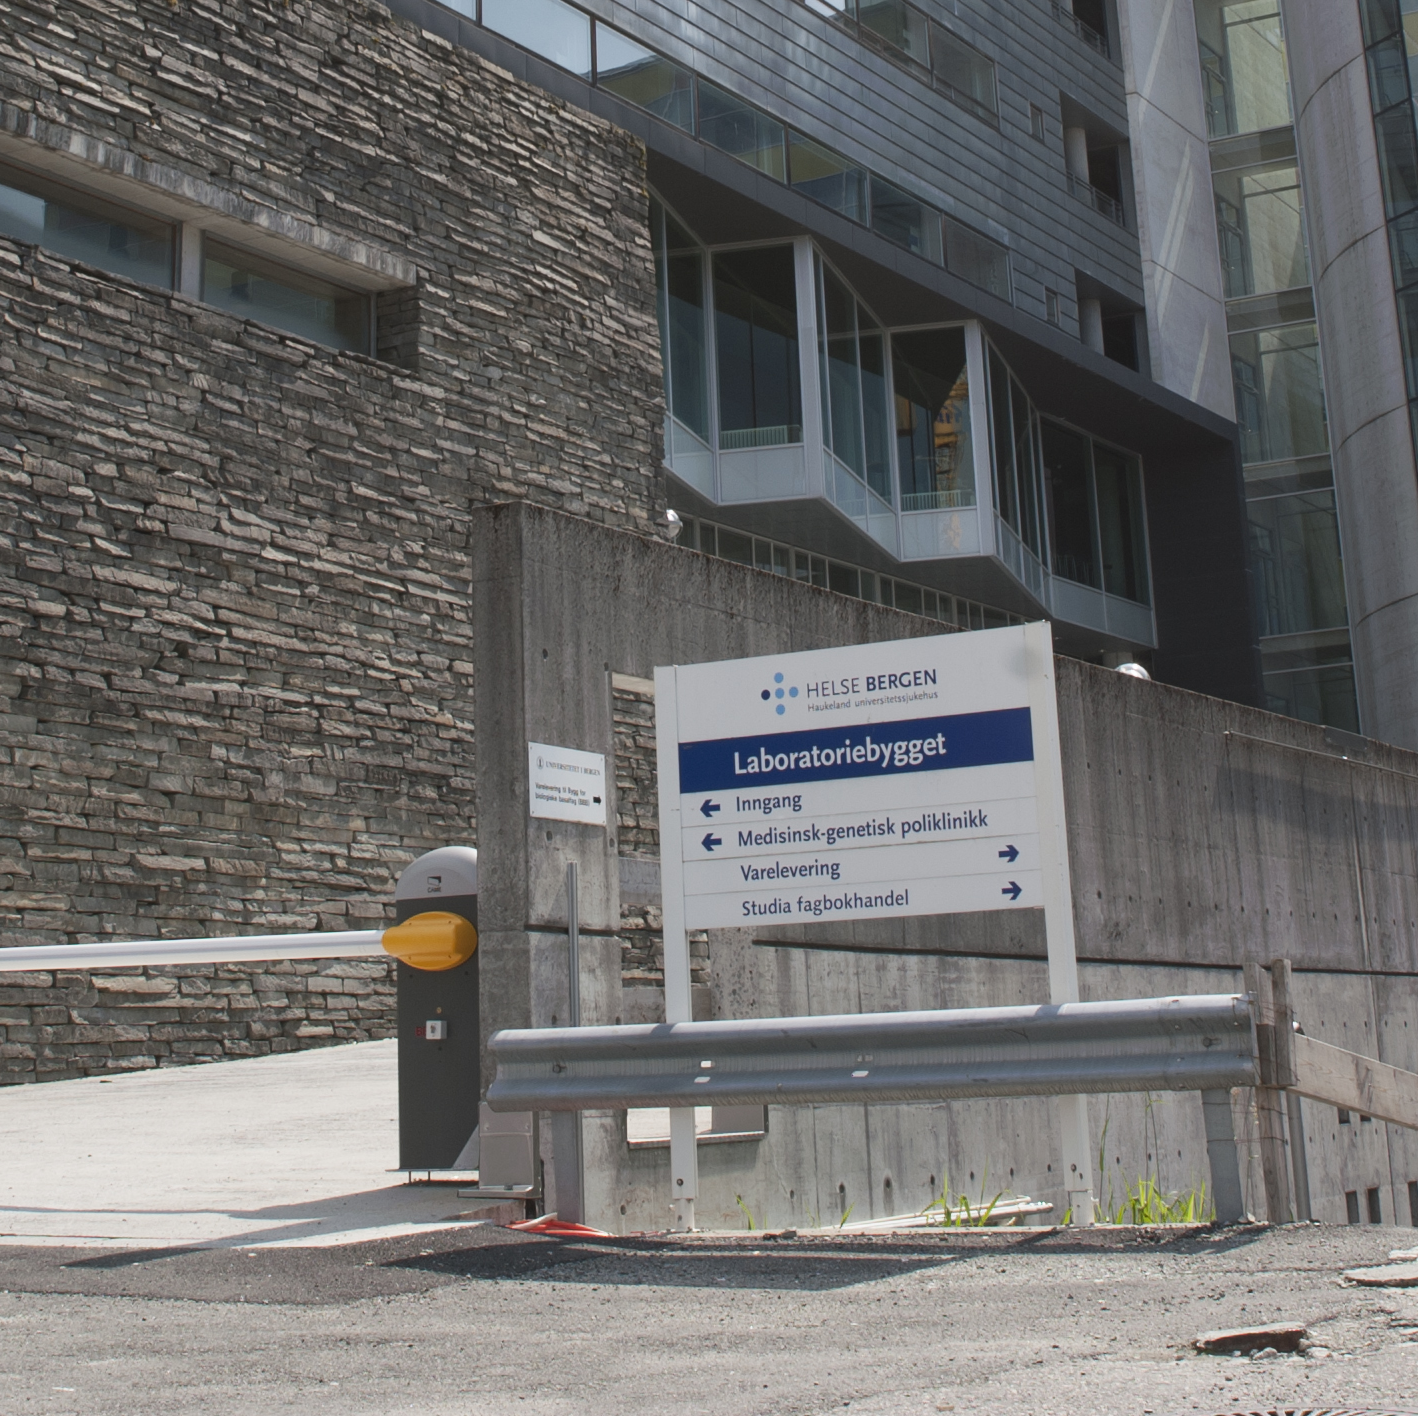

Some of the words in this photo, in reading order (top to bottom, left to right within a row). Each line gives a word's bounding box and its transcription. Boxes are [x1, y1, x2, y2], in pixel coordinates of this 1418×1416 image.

[807, 678, 860, 698] HELSE
[866, 669, 937, 692] BERGEN
[807, 699, 851, 712] Haukeland
[854, 691, 939, 708] universitetssjukehus
[734, 733, 947, 775] Laboratoriebygget
[736, 792, 803, 815] Inngang
[738, 817, 896, 847] Medisinsk-genetisk
[901, 809, 989, 839] poliklinikk
[740, 859, 841, 882] Varelevering
[742, 896, 792, 916] Studia
[797, 889, 910, 916] fagbokhandel
